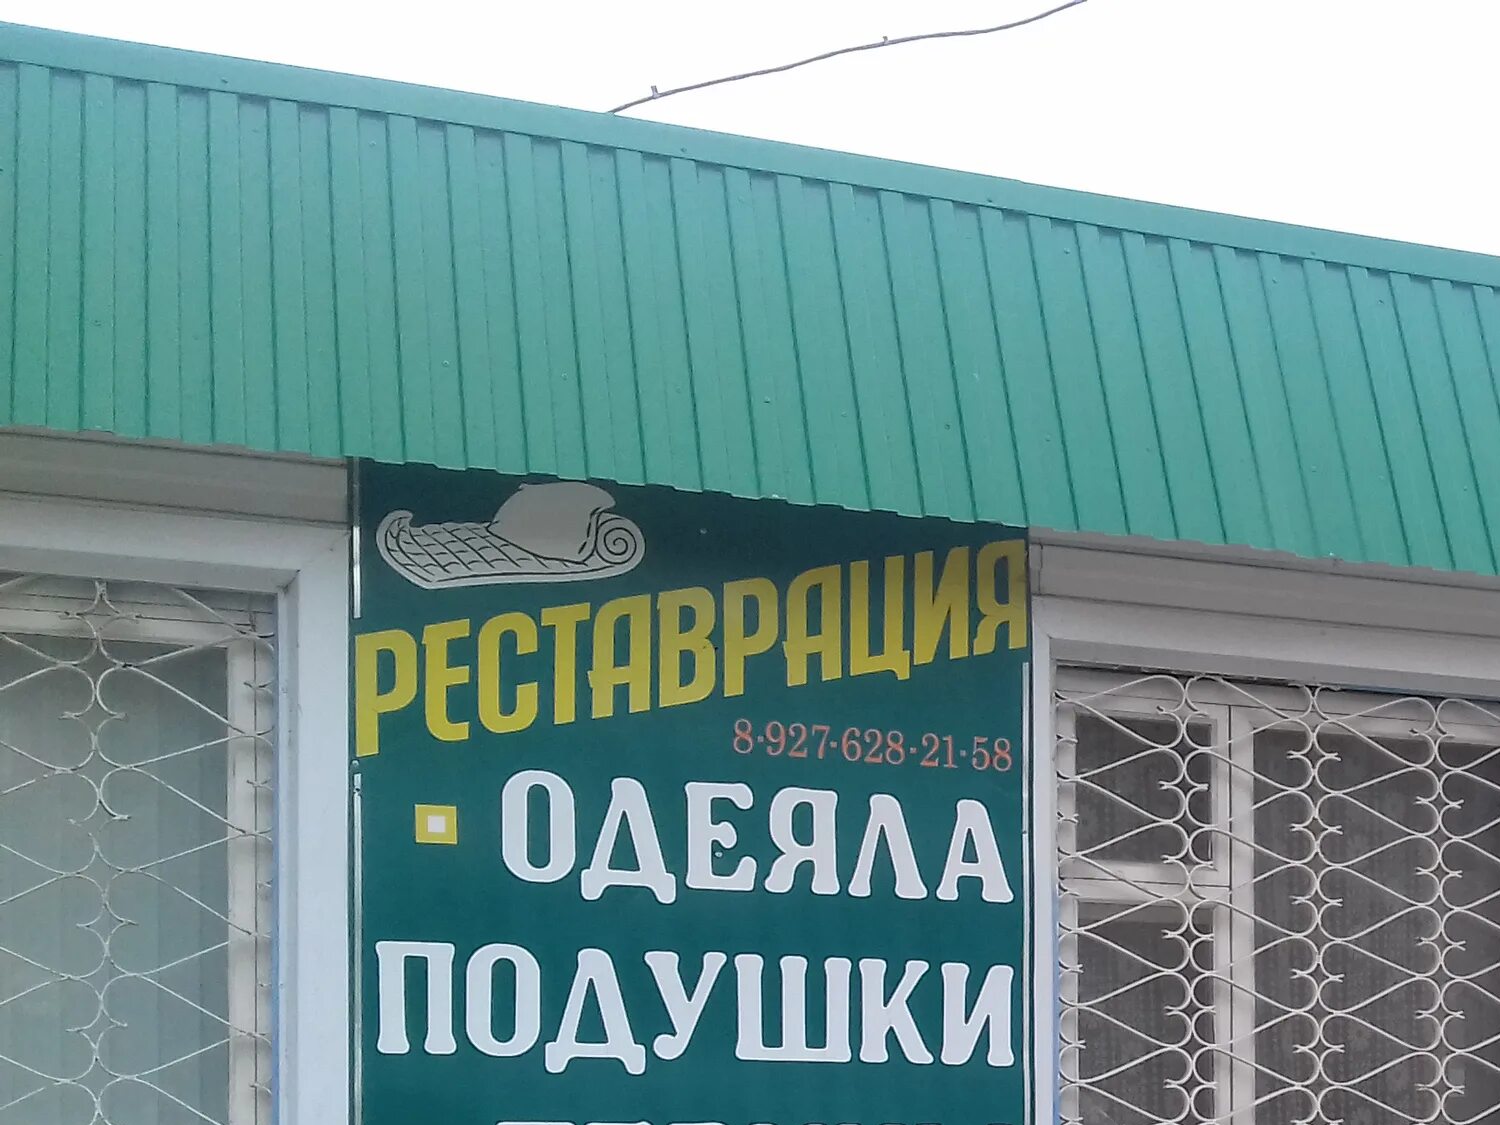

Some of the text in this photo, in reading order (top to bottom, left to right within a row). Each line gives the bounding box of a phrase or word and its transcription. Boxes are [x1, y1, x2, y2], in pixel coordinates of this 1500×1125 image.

[355, 539, 1028, 758] РЕСТАВРАЦИЯ
[501, 768, 1015, 905] ОДЕЯЛА
[375, 940, 1015, 1076] ПОДУШКИ
